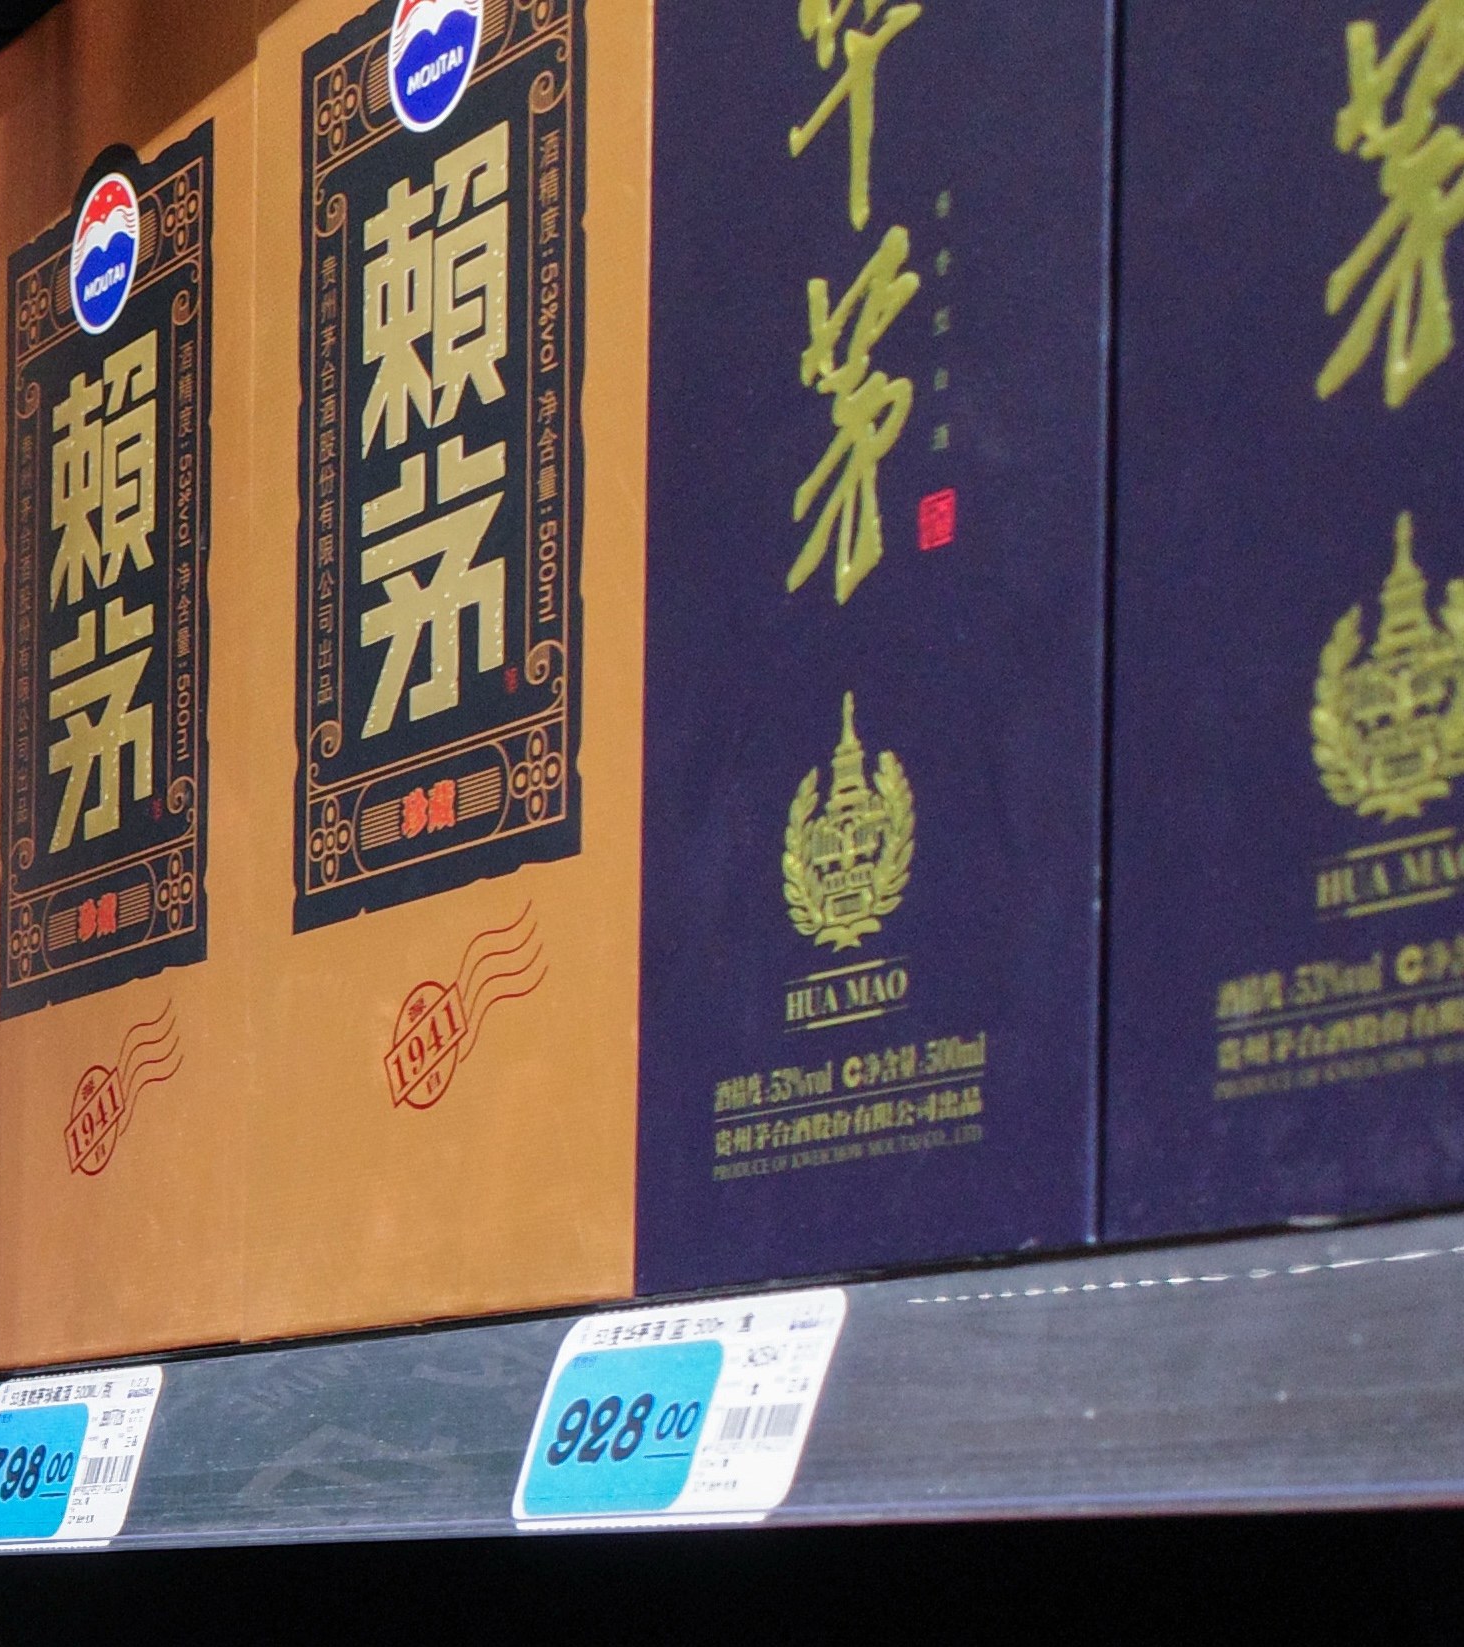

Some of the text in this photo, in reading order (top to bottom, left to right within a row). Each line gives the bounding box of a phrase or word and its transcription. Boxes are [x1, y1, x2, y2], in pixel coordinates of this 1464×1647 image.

[406, 45, 465, 97] MOUTAI
[83, 261, 127, 303] MOUTAI
[315, 253, 341, 707] 贵州茅台酒股份有限公司出品
[536, 388, 563, 625] 净含量:500ml
[785, 968, 909, 1022] HUA MAO
[389, 998, 463, 1096] 1941
[69, 1083, 123, 1161] 1941
[546, 1393, 701, 1467] 928 00
[45, 1451, 75, 1485] 00
